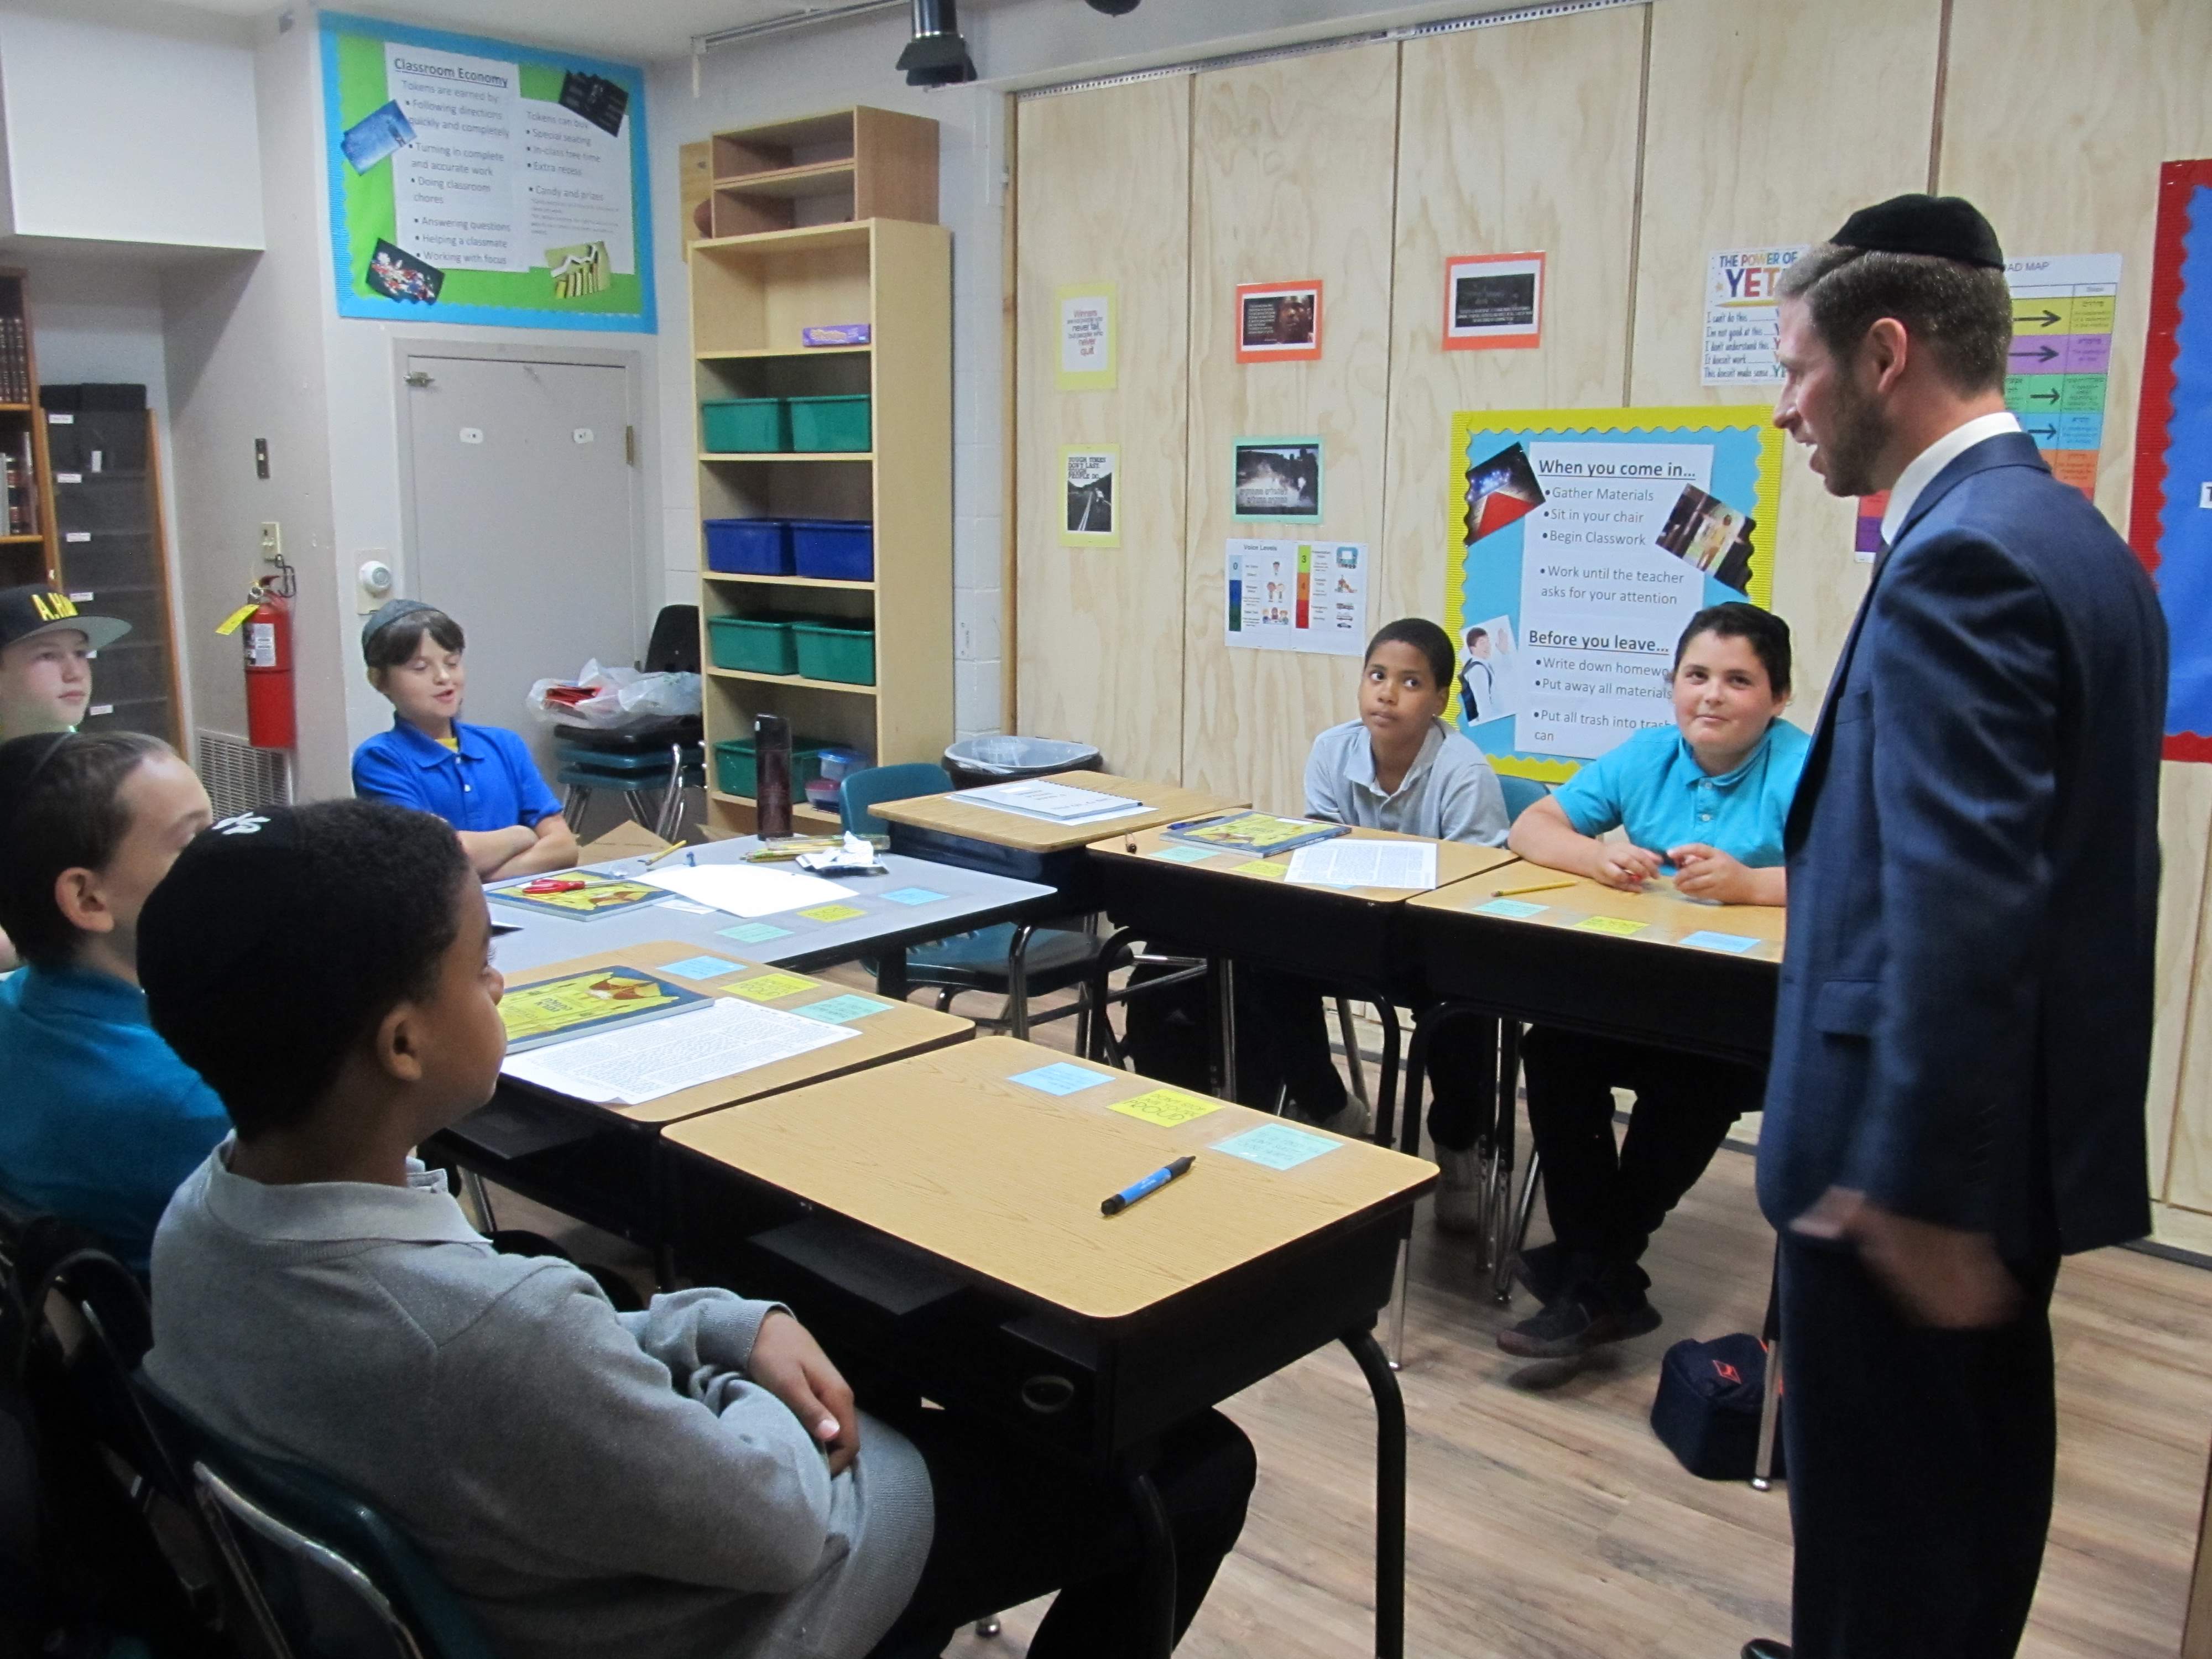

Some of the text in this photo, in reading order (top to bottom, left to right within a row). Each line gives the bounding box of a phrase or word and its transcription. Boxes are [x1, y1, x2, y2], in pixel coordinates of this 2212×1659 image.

[394, 58, 508, 87] Classroom Economy
[401, 80, 435, 92] Tokens
[437, 87, 452, 96] are
[455, 89, 485, 101] earned
[413, 100, 503, 119] Following directions
[442, 122, 460, 131] and
[462, 124, 509, 138] completely
[416, 142, 504, 161] Turning in complete
[411, 160, 494, 176] and accurate work
[534, 161, 556, 172] Extra
[418, 176, 491, 192] Doing classroom
[536, 185, 561, 197] Candy
[563, 189, 580, 198] and
[414, 192, 444, 204] chores
[422, 217, 511, 232] Answering questions
[422, 234, 456, 247] Helping
[466, 236, 507, 248] classmate
[424, 251, 507, 264] Working with focus
[1720, 251, 1797, 268] THE POWER OF
[2026, 262, 2049, 271] MAP
[1725, 267, 1780, 298] YET
[1707, 311, 1712, 323] I
[1539, 459, 1695, 477] When you come in...
[1552, 487, 1654, 501] Gather Materials
[1551, 508, 1644, 523] Sit in your chair
[1550, 530, 1646, 546] Begin Classwork
[1233, 562, 1238, 570] 0
[1548, 565, 1684, 584] Work until the teacher
[1541, 586, 1677, 604] asks for your attention
[1530, 630, 1669, 653] Before you leave...
[1543, 656, 1669, 676] Write down homewo
[1542, 678, 1673, 699] Put away all materials
[1541, 709, 1561, 721] Put
[1563, 712, 1577, 723] all
[1580, 714, 1609, 726] trash
[1613, 716, 1636, 728] into
[1534, 731, 1554, 742] can
[1123, 1099, 1185, 1120] PROUD
